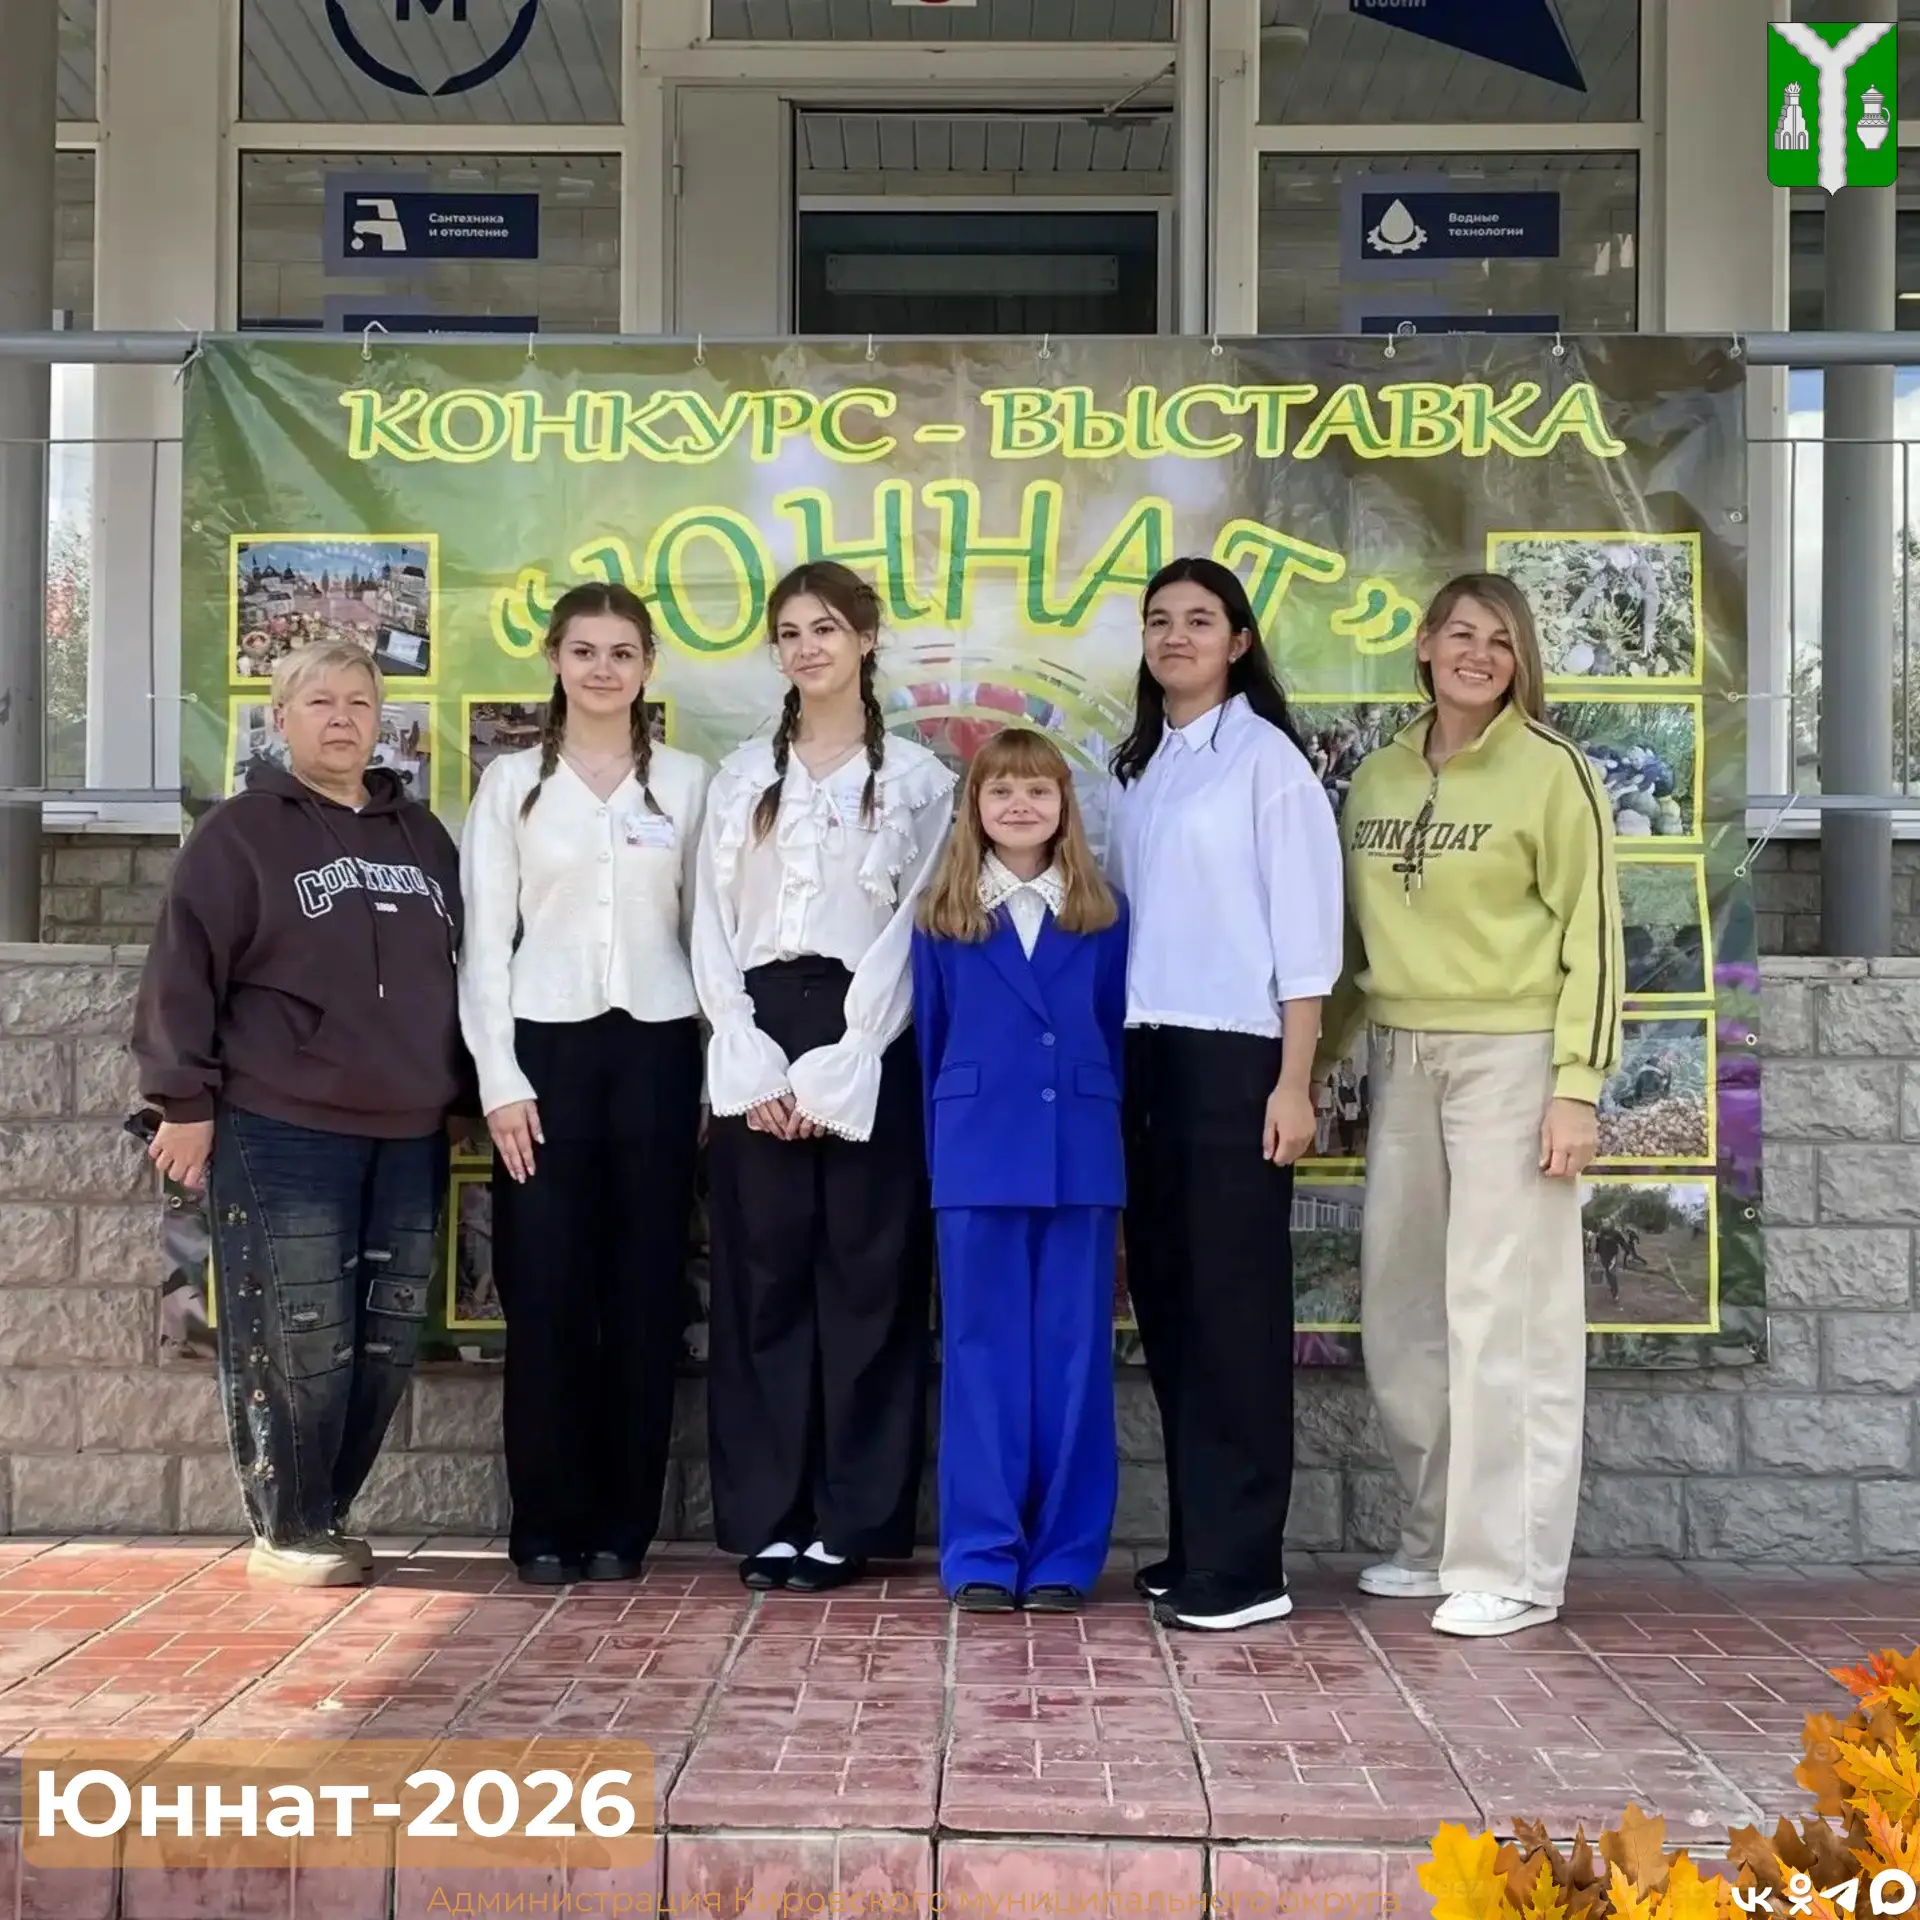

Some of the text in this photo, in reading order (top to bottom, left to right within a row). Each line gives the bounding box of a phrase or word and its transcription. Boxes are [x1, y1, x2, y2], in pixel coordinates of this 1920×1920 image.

[428, 212, 504, 223] Сантехника
[1448, 212, 1500, 224] Водные
[428, 228, 509, 237] и отопление
[1448, 227, 1524, 236] технологии
[340, 388, 898, 463] КОНКУРС
[981, 383, 1626, 460] ВЫСТАВКА
